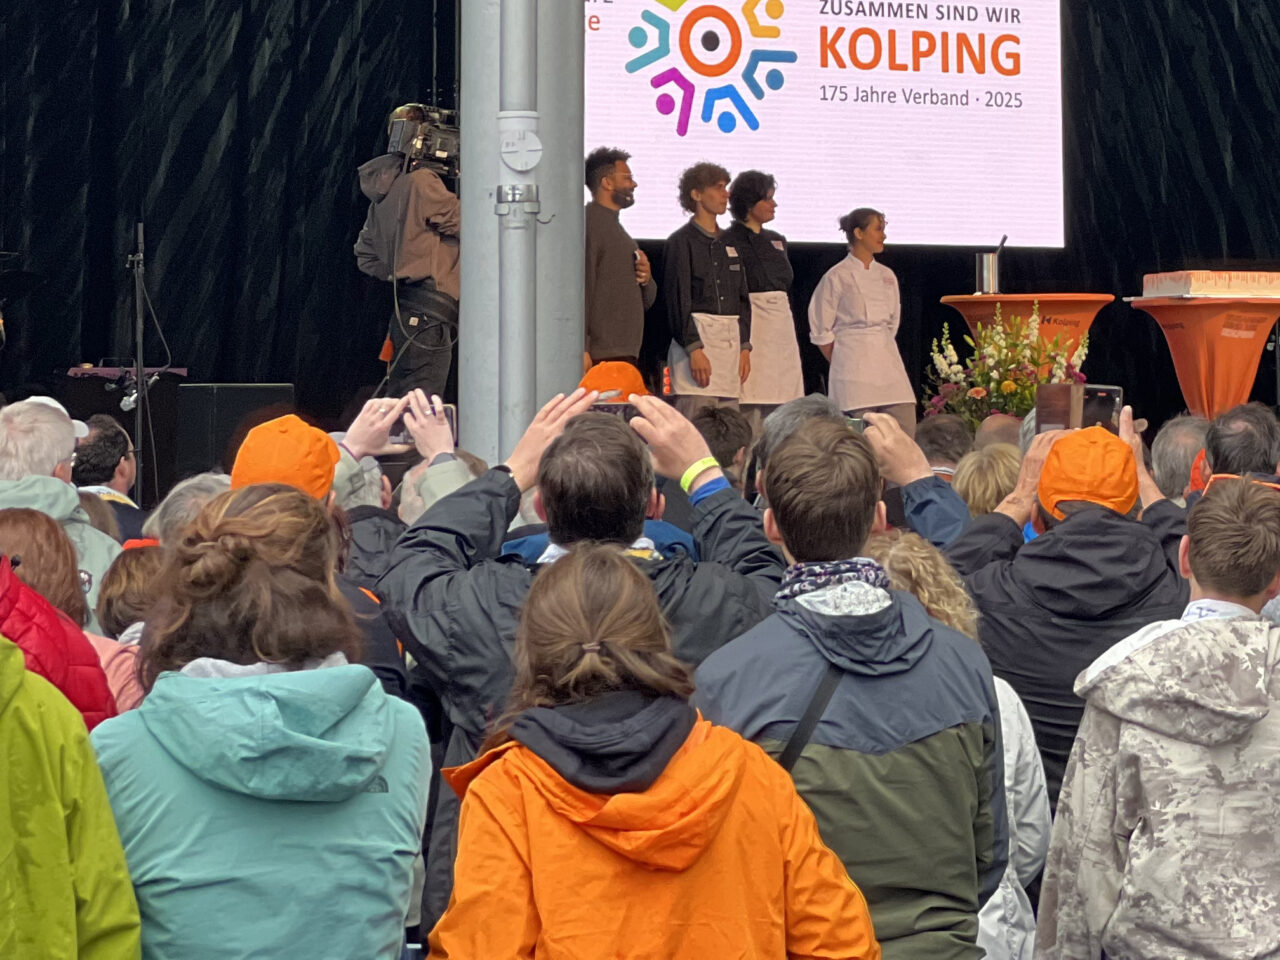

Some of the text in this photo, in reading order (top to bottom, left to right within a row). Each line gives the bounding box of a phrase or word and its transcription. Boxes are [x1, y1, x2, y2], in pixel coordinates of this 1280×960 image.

[935, 4, 979, 22] SIND
[985, 6, 1021, 24] WIR
[819, 25, 1021, 77] KOLPING
[819, 85, 1023, 109] 175 Jahre Verband 2025
